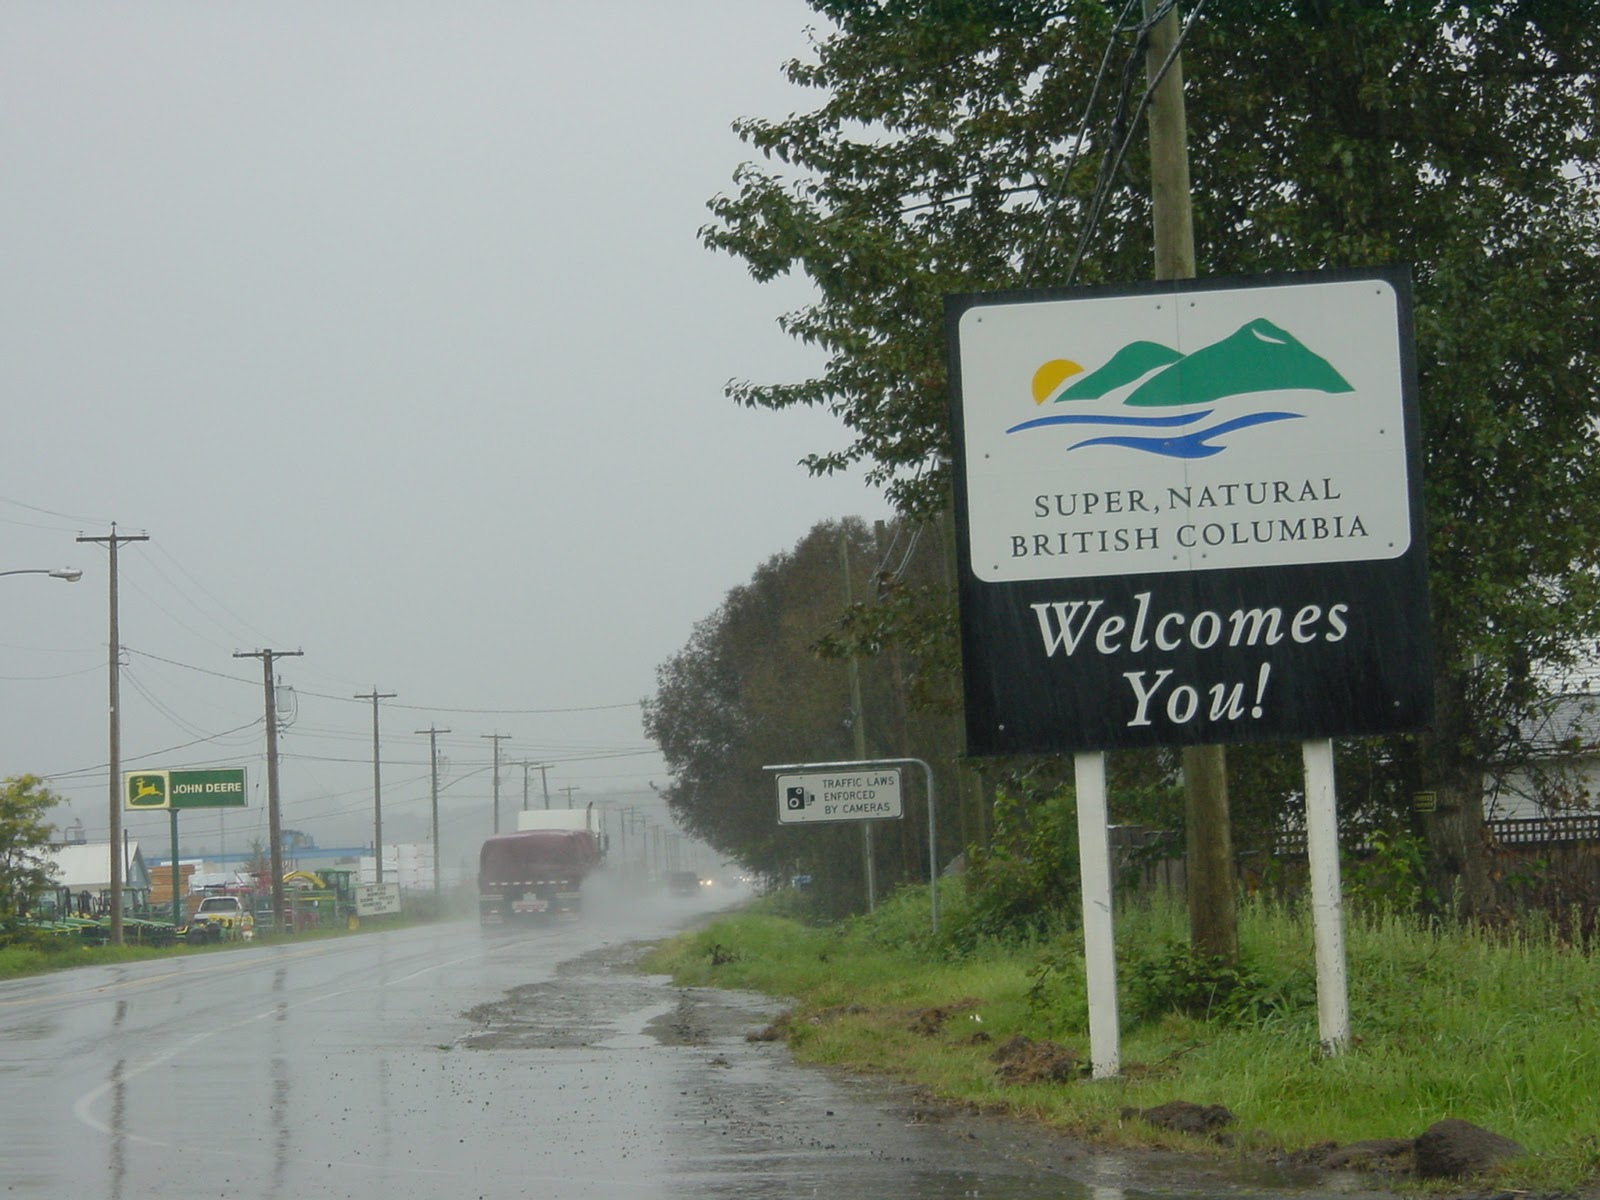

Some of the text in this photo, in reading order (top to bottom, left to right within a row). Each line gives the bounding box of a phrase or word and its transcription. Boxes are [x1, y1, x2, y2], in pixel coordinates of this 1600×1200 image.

[1167, 478, 1342, 510] NATURAL
[1011, 515, 1369, 558] BRITISH COLUMBIA
[1030, 592, 1349, 658] Welcomes
[1123, 662, 1271, 727] You!
[172, 782, 242, 794] JOHN DEERE
[823, 776, 894, 789] TRAFFIC LAWS
[824, 790, 876, 801] ENFORCED
[825, 803, 890, 815] BY CAMERAS
